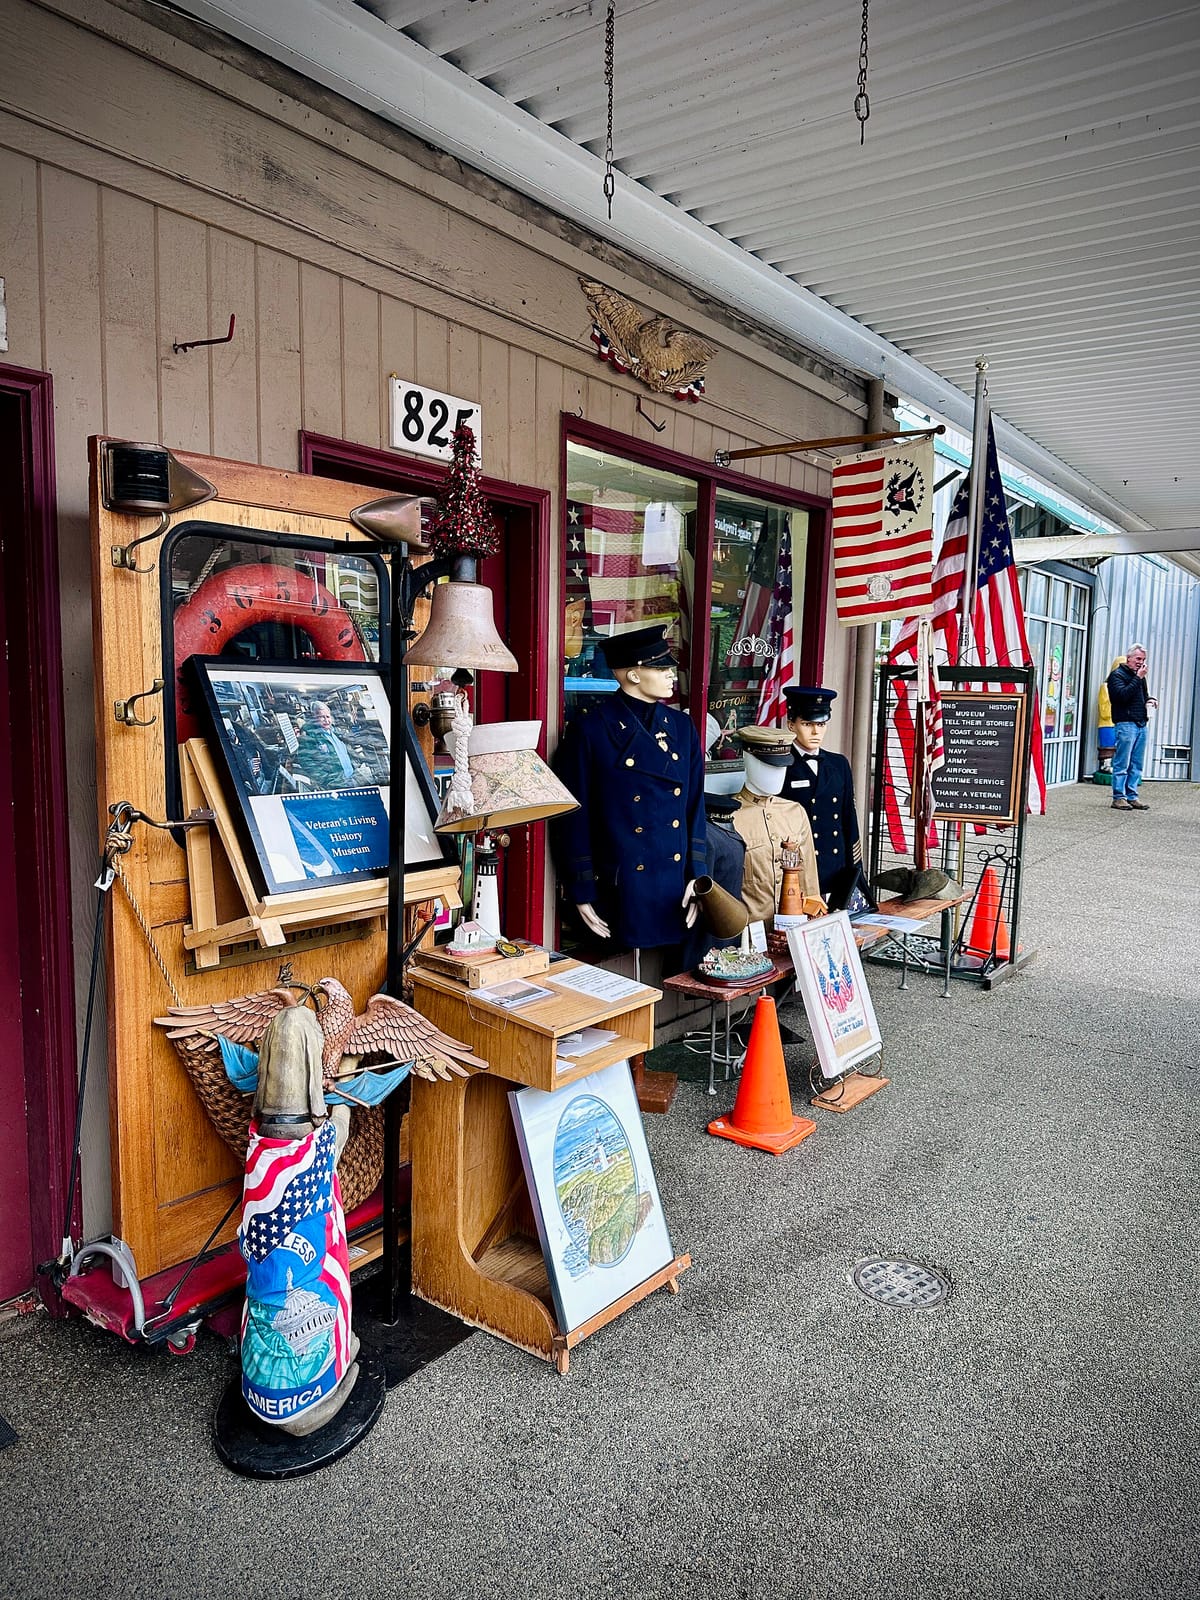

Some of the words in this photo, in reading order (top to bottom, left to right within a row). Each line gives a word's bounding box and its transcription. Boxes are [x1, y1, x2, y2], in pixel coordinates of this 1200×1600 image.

[935, 776, 971, 784] MARITIME
[973, 778, 1005, 786] SERVICE
[970, 791, 1002, 799] VETERAN
[305, 817, 348, 830] Veteran's
[349, 815, 378, 826] Living
[329, 832, 363, 843] History
[331, 845, 371, 858] Museum
[280, 1235, 315, 1263] LESS
[247, 1384, 322, 1416] AMERICA
